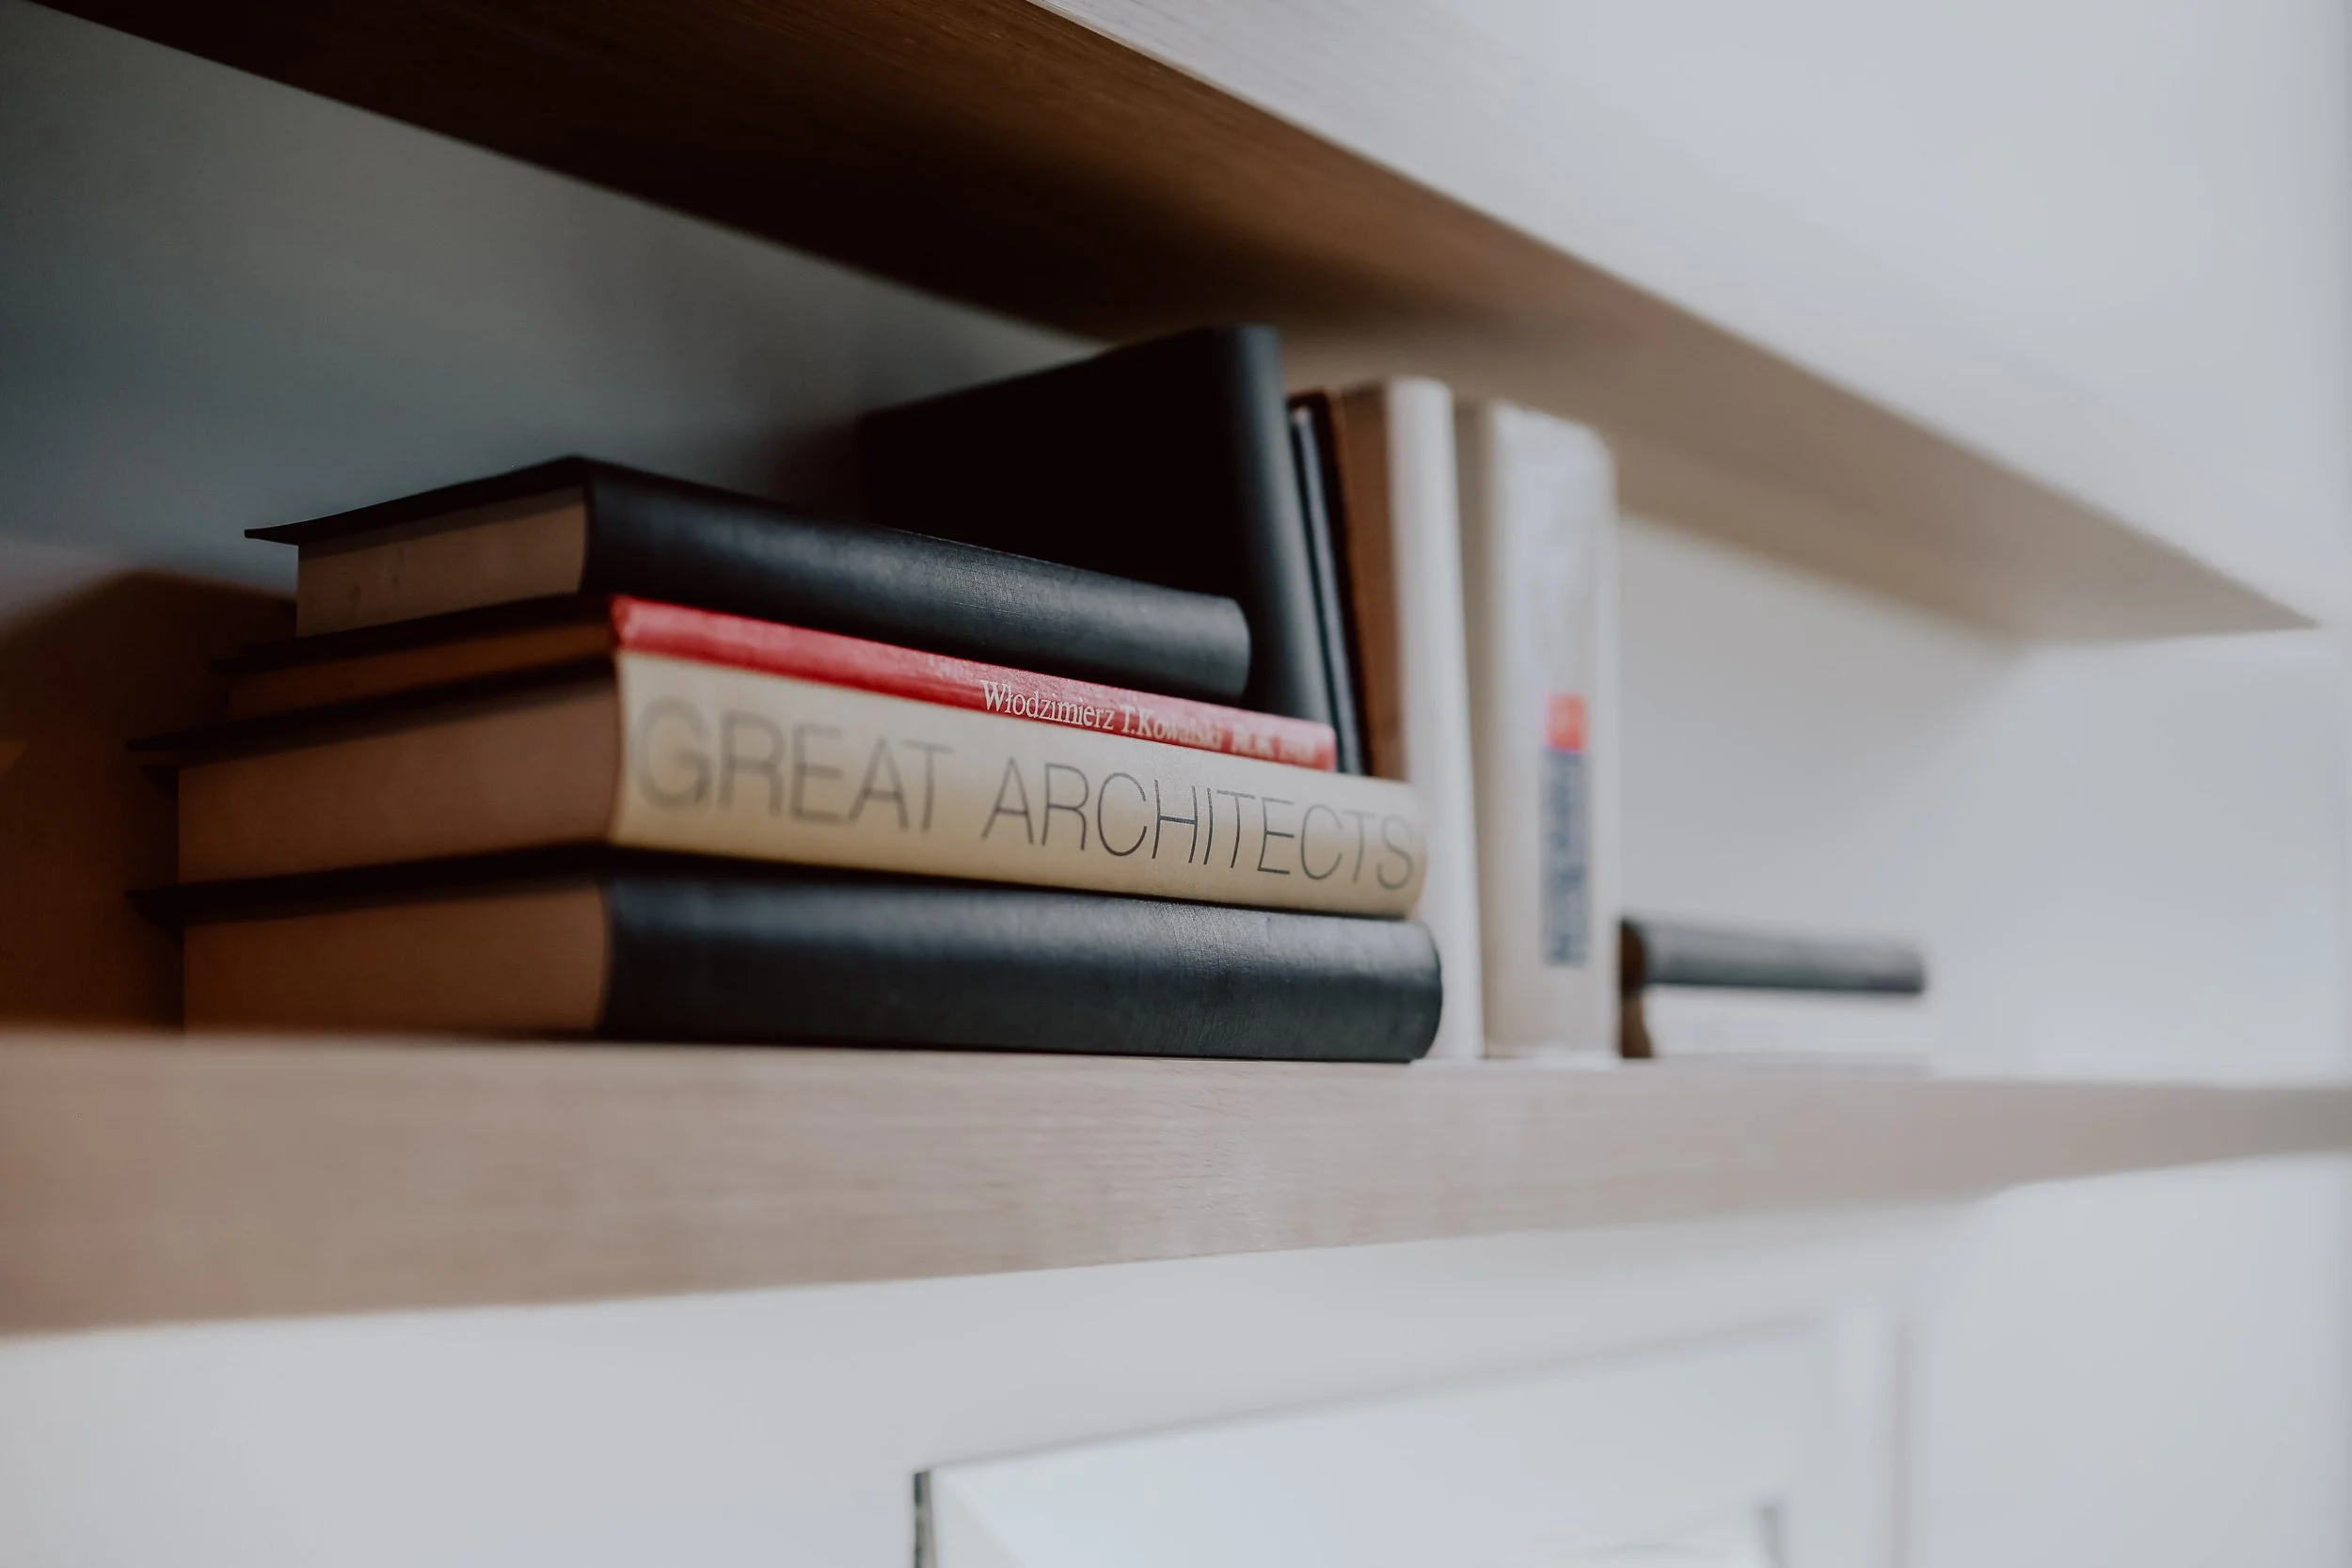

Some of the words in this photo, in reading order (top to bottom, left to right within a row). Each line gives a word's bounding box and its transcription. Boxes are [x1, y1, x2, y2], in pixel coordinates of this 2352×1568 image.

[981, 679, 1114, 731] Włodzimierz
[634, 695, 953, 833] GREAT
[980, 757, 1416, 890] ARCHITECTS
